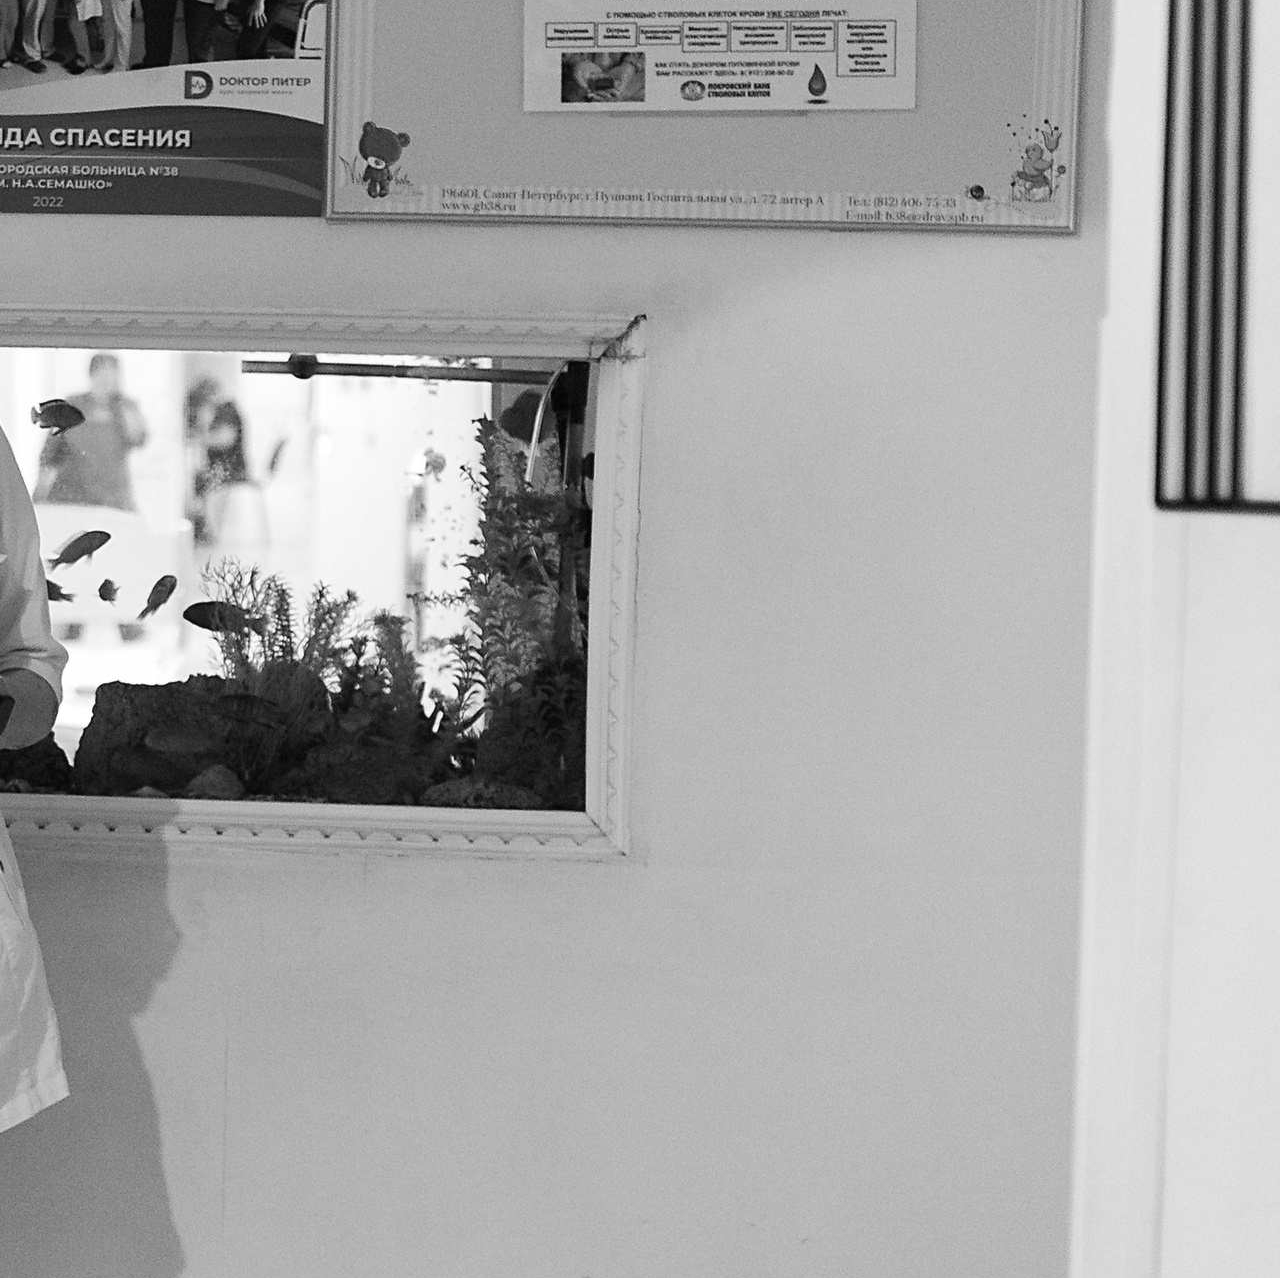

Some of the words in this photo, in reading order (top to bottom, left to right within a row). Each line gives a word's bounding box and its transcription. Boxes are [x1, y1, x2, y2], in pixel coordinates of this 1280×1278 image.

[271, 77, 312, 87] ПИТЕР
[50, 127, 192, 149] СПАСЕНИЯ
[72, 165, 147, 177] БОЛЬНИЦА
[32, 196, 64, 208] 2022
